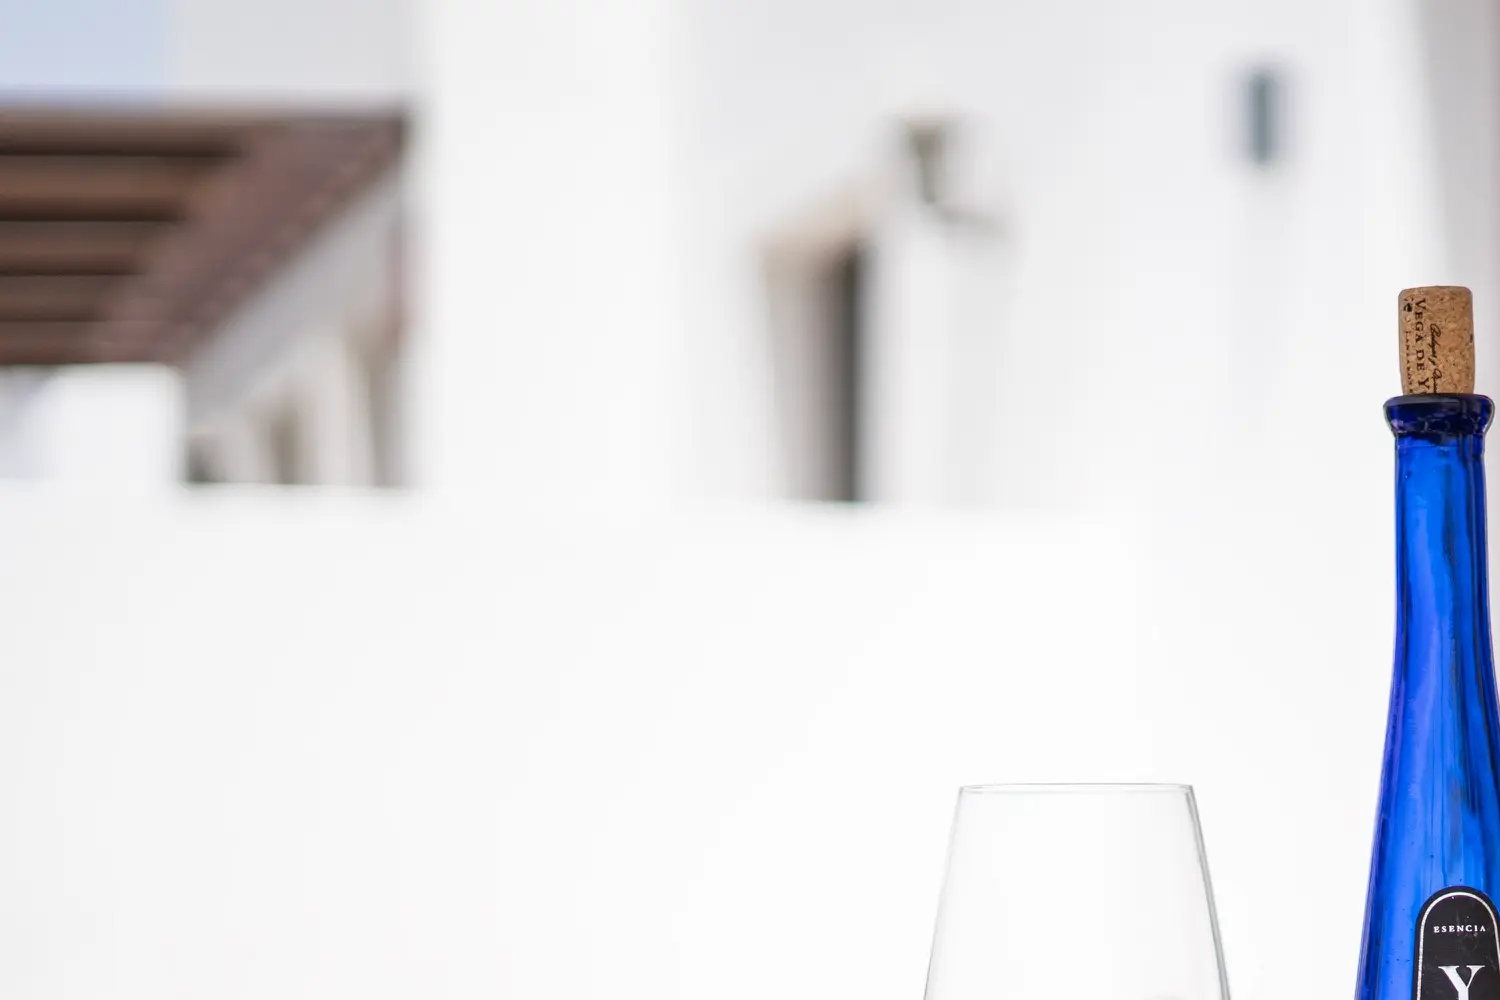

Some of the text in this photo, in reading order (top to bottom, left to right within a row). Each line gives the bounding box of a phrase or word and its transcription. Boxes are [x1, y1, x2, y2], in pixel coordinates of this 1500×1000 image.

[1414, 298, 1427, 342] VEGA
[1416, 350, 1425, 372] DE
[1433, 924, 1486, 934] ESENCIA
